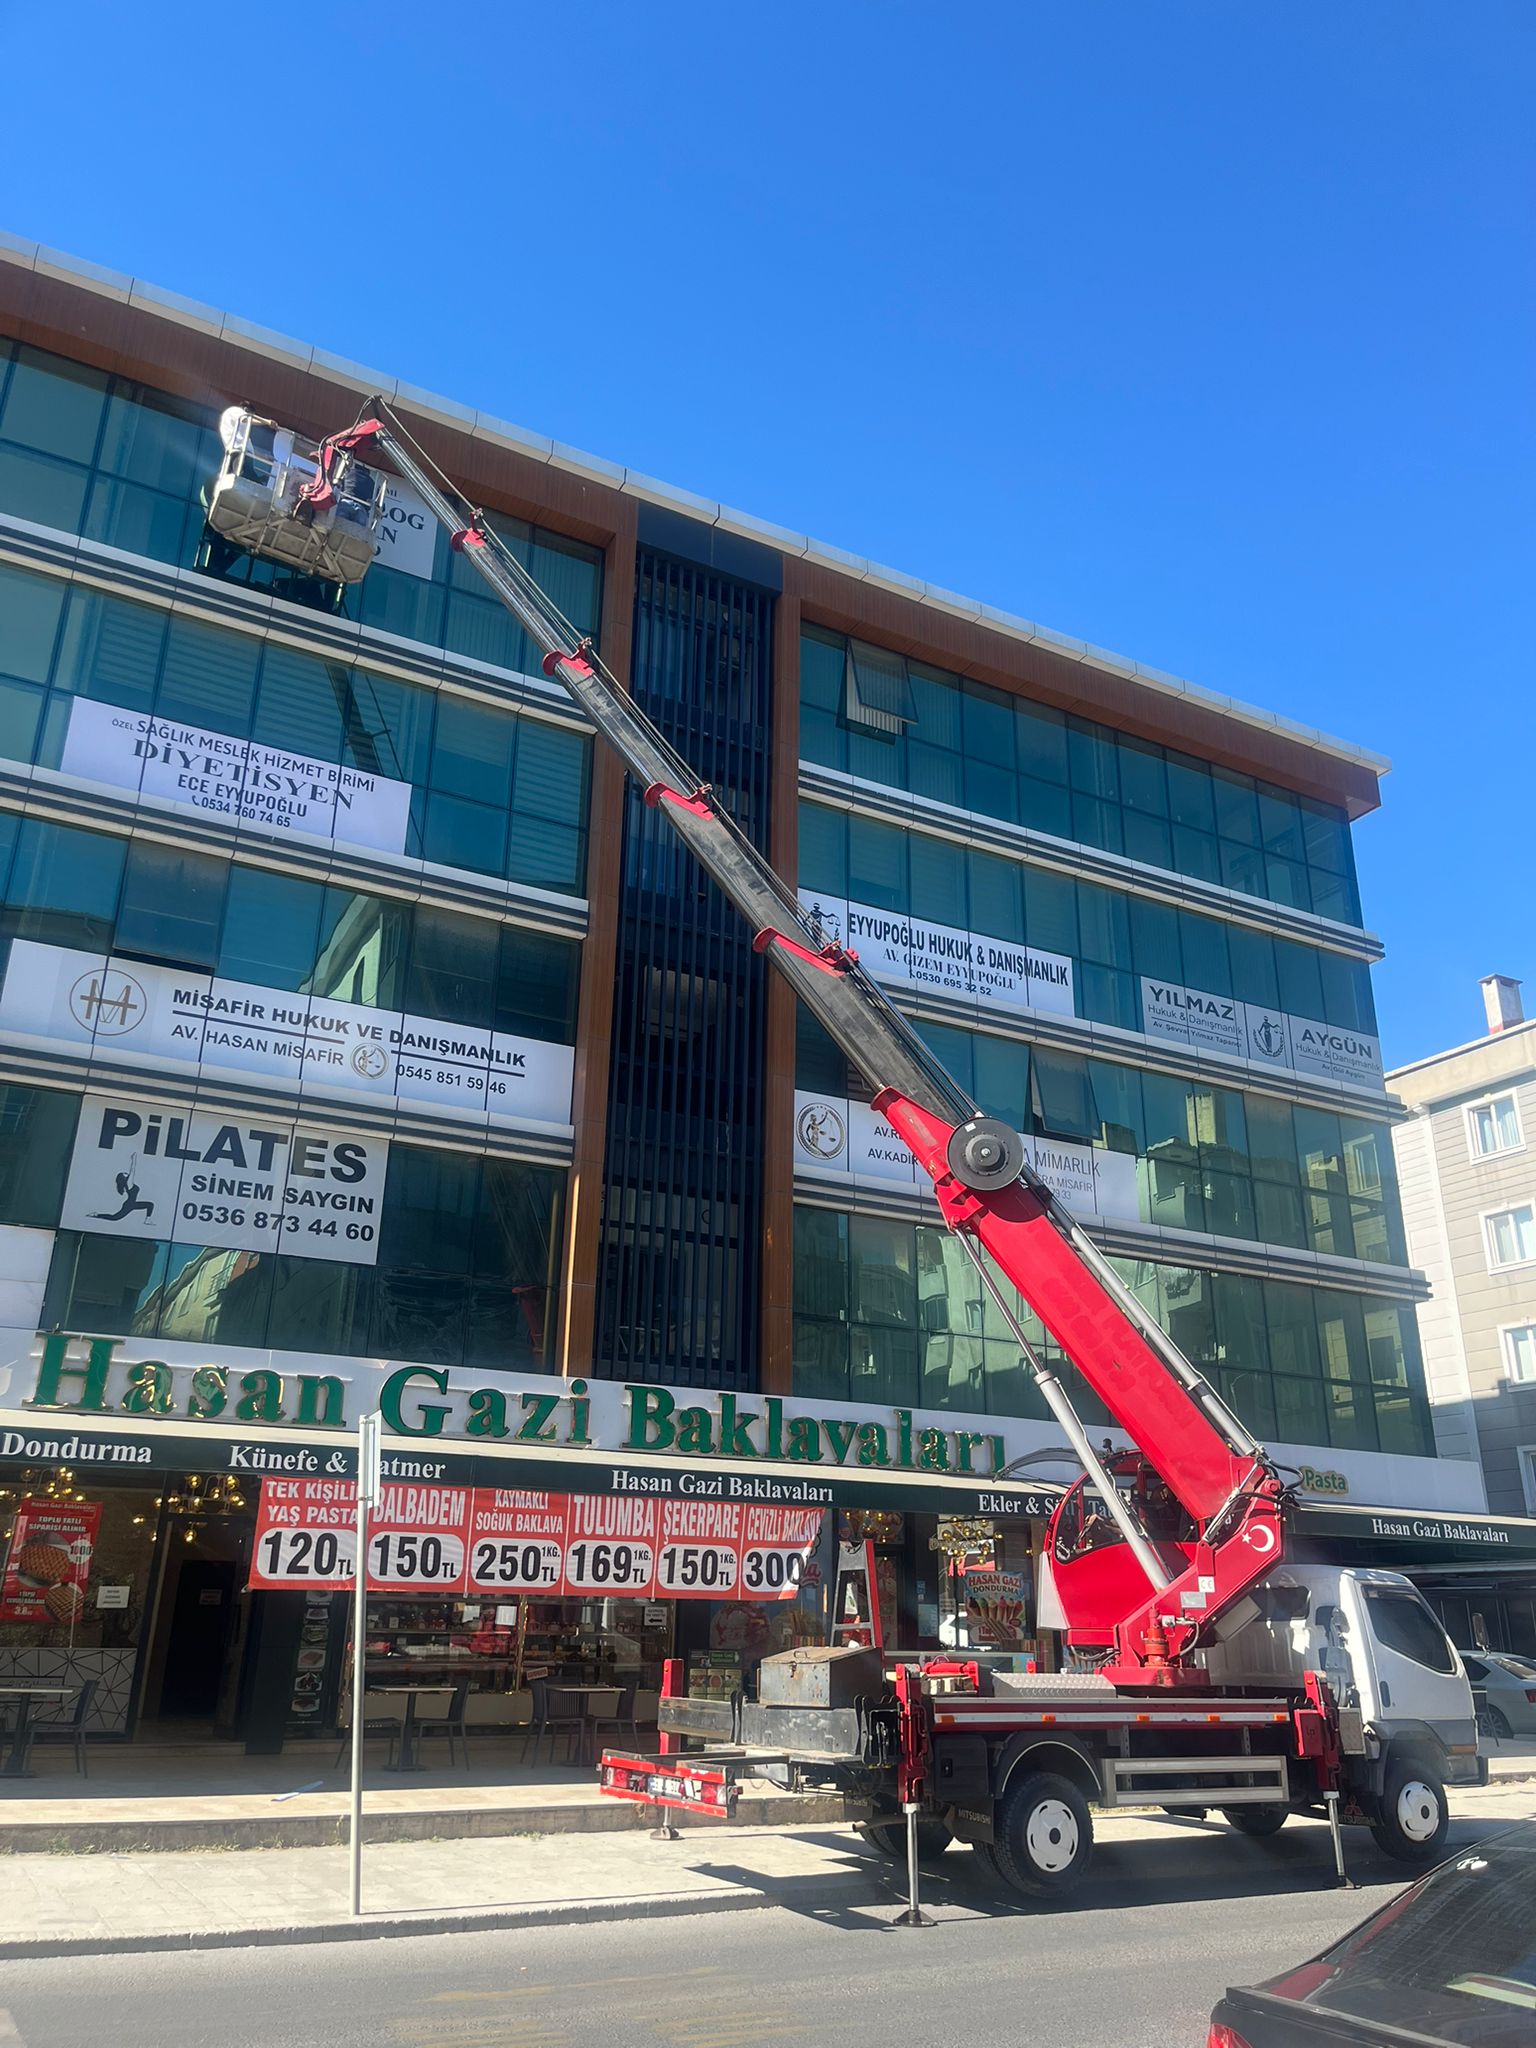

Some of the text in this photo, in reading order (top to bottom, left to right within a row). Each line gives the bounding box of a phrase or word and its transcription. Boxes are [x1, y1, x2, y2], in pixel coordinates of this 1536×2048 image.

[111, 718, 134, 731] ÖZEL
[137, 720, 194, 746] SAĞLIK
[199, 736, 260, 762] MESLEK
[264, 753, 324, 779] HİZMET
[130, 738, 355, 810] DİYETİSYEN
[178, 773, 307, 818] ECE EYYUPOĞLU
[201, 796, 291, 828] 0534 760 74 65
[849, 912, 1069, 986] EYYUPOĞLU HUKUK & DANIŞMANLIK
[883, 948, 899, 962] AV.
[904, 951, 943, 973] GİZEM
[916, 970, 941, 984] 0530
[943, 978, 962, 990] 695
[979, 986, 992, 996] 52
[1149, 985, 1234, 1021] YILMAZ
[173, 989, 526, 1068] MİSAFİR HUKUK VE DANIŞMANLIK
[1148, 1004, 1177, 1019] Hukuk
[1188, 1014, 1243, 1036] Danışmanlk
[171, 1024, 344, 1066] AV. HASAN MİSAFİR
[1295, 1042, 1322, 1057] Hukuk
[1301, 1028, 1373, 1059] AYGÜN
[396, 1064, 506, 1095] 0545 851 59 46
[1035, 1149, 1102, 1177] MİMARLIK
[191, 1173, 374, 1214] SİNEM SAYGIN
[182, 1202, 374, 1242] 0536 873 44 60
[21, 1330, 1007, 1474] Hasan Gazi Baklavaları
[0, 1431, 153, 1464] Dondurma
[228, 1445, 446, 1480] Künefe & atmer
[266, 1480, 359, 1504] TEK KİŞİLİ
[611, 1470, 834, 1502] Hasan Gazi Baklavaları
[1305, 1469, 1347, 1491] Pasta
[267, 1505, 358, 1526] YAŞ PASTA
[372, 1486, 466, 1526] BALBADEM
[495, 1489, 549, 1510] KAYMAKLI
[978, 1493, 1022, 1513] Ekler
[1025, 1496, 1040, 1515] &
[63, 1517, 82, 1525] TATLI
[475, 1509, 563, 1533] SOĞUK BAKLAVA
[573, 1495, 654, 1537] TULUMBA
[663, 1500, 740, 1545] ŞEKERPARE
[1372, 1518, 1510, 1543] Hasan Gazi Baklavaları
[264, 1531, 354, 1576] 120 TL
[374, 1534, 457, 1578] 150 TL
[475, 1543, 542, 1582] 250
[572, 1544, 632, 1583] 169
[663, 1547, 719, 1586] 150
[746, 1551, 804, 1588] 300
[541, 1566, 557, 1582] TL
[632, 1568, 646, 1583] TL
[719, 1571, 732, 1586] TL
[968, 1575, 1001, 1587] HASAN
[972, 1584, 1019, 1596] DONDURMA
